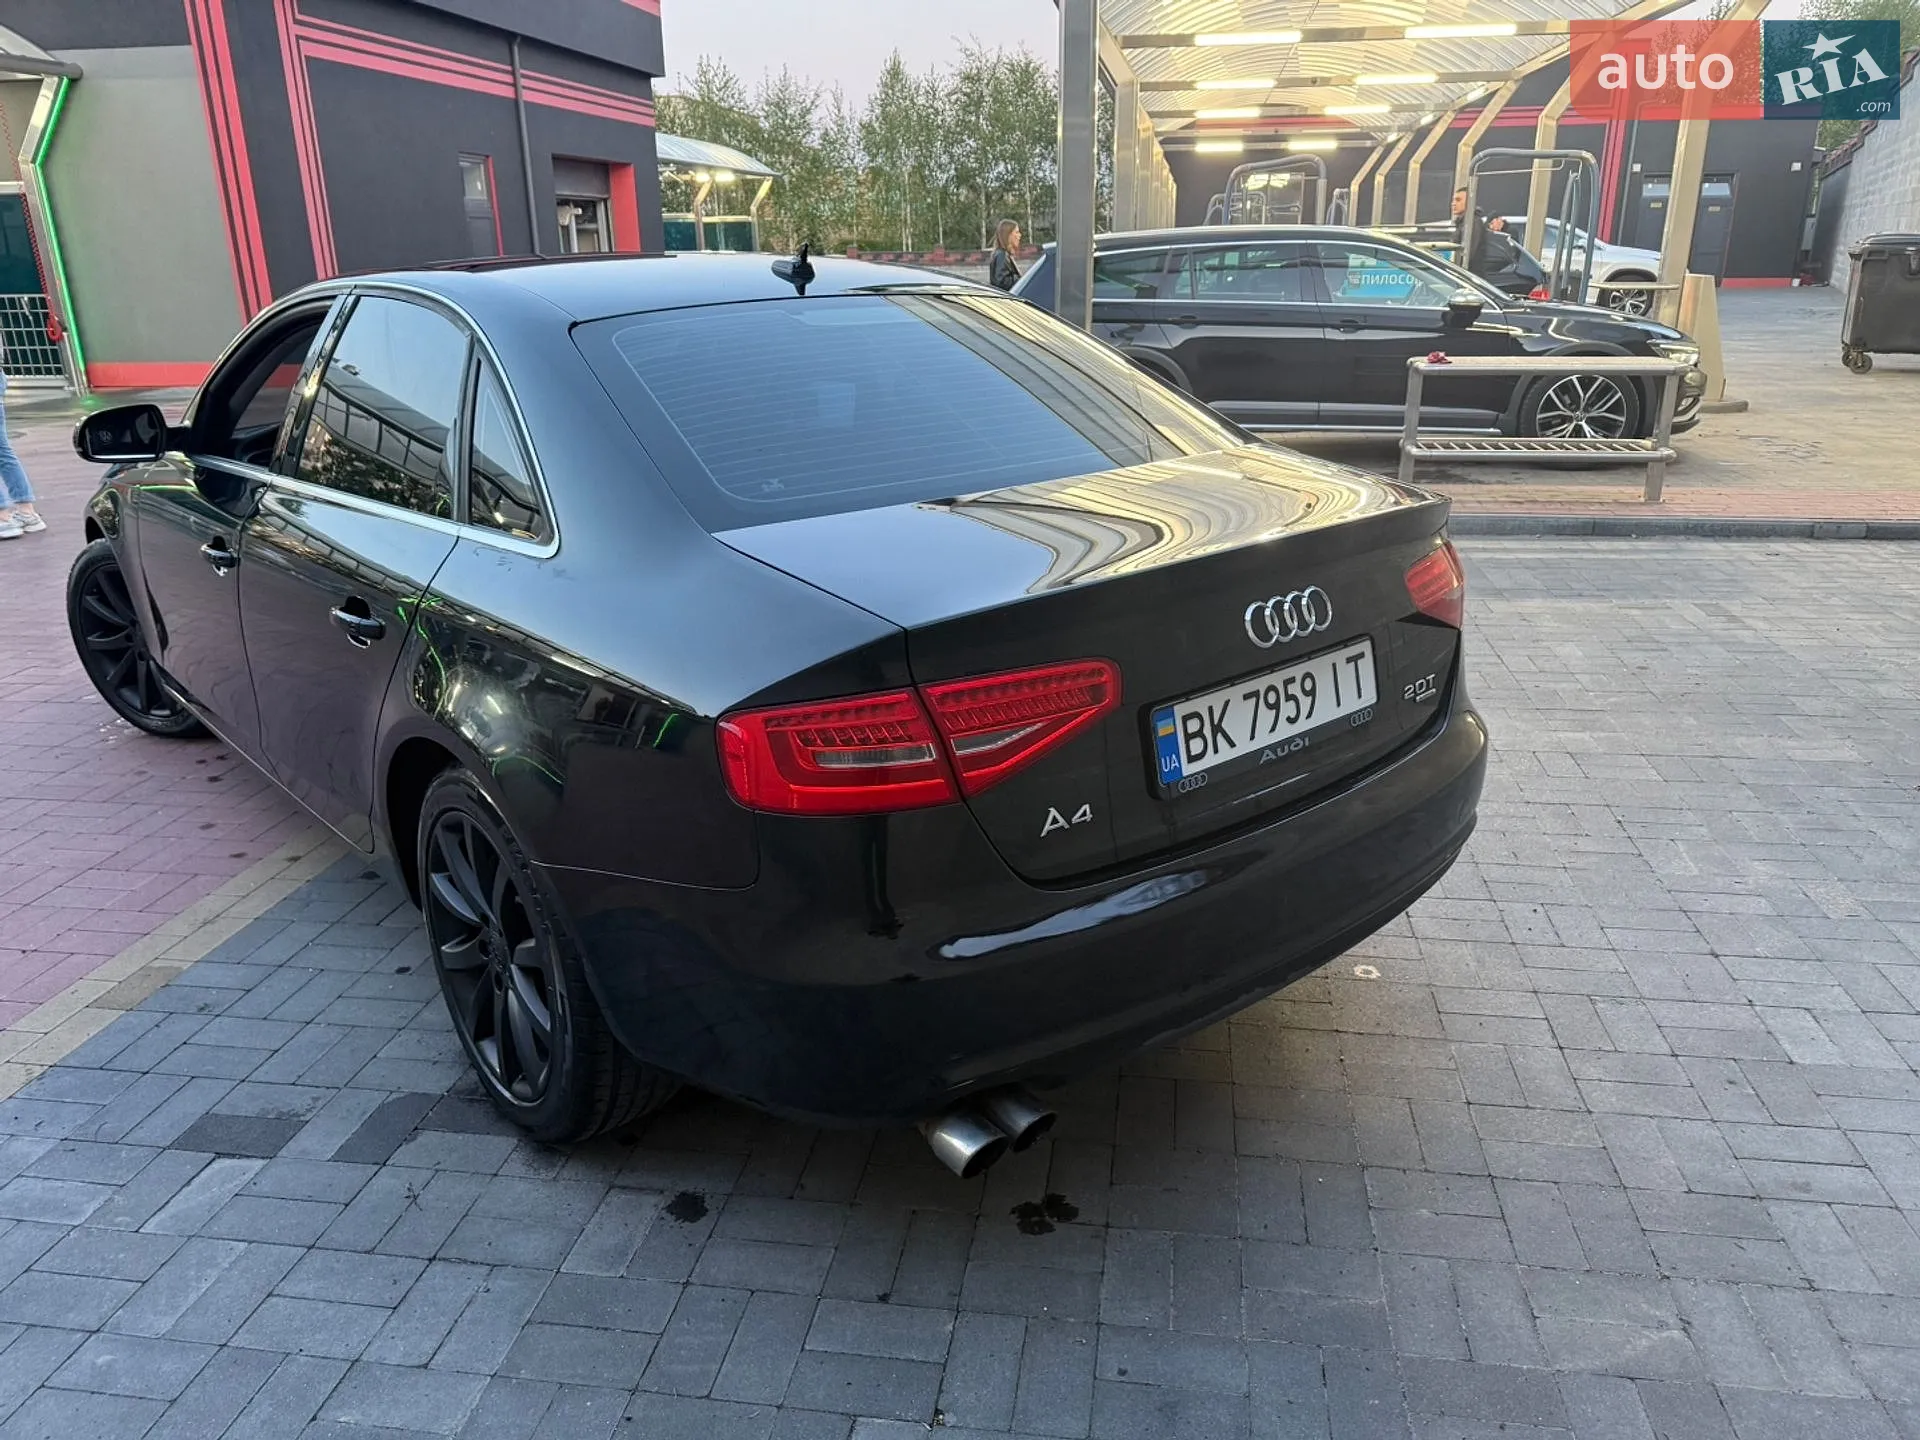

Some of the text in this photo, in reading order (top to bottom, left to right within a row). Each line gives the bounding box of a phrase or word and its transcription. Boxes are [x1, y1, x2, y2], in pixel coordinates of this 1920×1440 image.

[1181, 651, 1366, 764] BK 7959 IT
[1161, 753, 1180, 773] UA
[1259, 736, 1310, 765] Audi
[1040, 803, 1093, 838] A4
